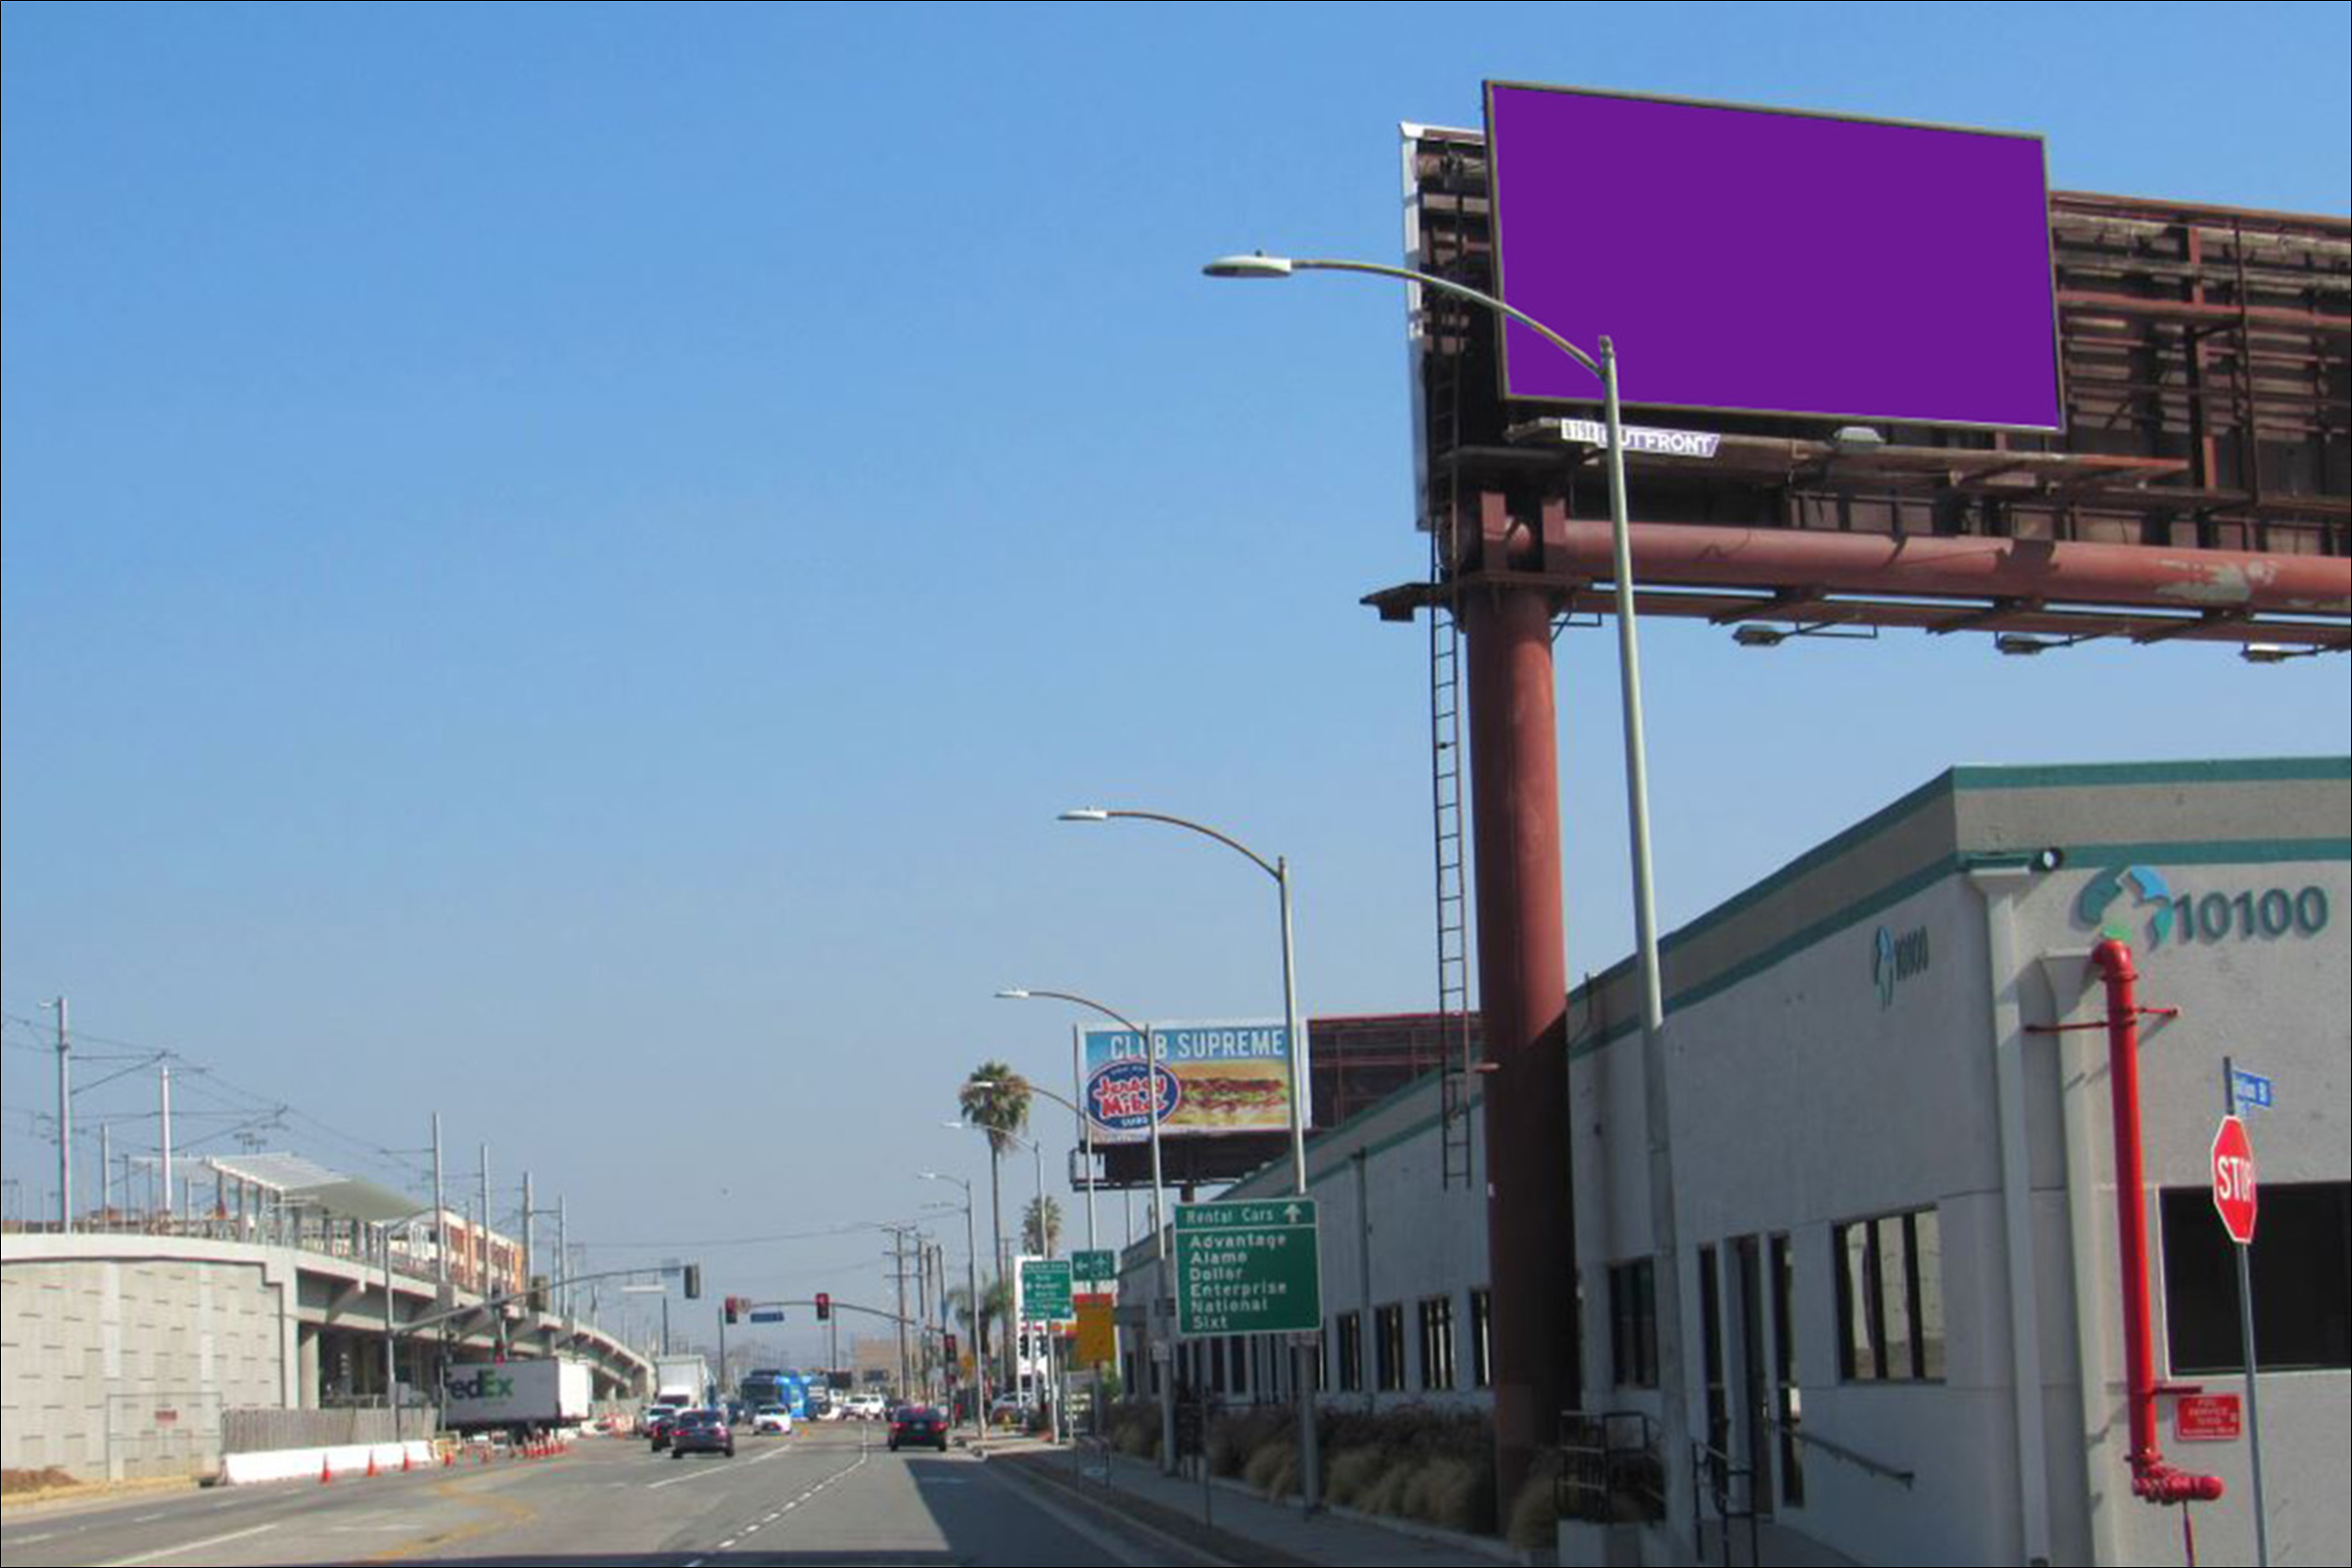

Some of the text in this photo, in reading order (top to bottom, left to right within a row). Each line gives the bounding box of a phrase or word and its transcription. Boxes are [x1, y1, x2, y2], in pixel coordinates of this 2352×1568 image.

[1602, 426, 1711, 455] UTFRONT
[2173, 885, 2328, 941] 10100
[1178, 1030, 1284, 1057] SUPREME
[1186, 1206, 1274, 1224] Rental Cars
[1190, 1234, 1287, 1250] Advantage
[1190, 1251, 1248, 1265] Alamo
[1190, 1266, 1244, 1282] Dollar
[1190, 1280, 1287, 1297] Enterprise
[1191, 1298, 1268, 1313] National
[1193, 1315, 1228, 1330] Sixt
